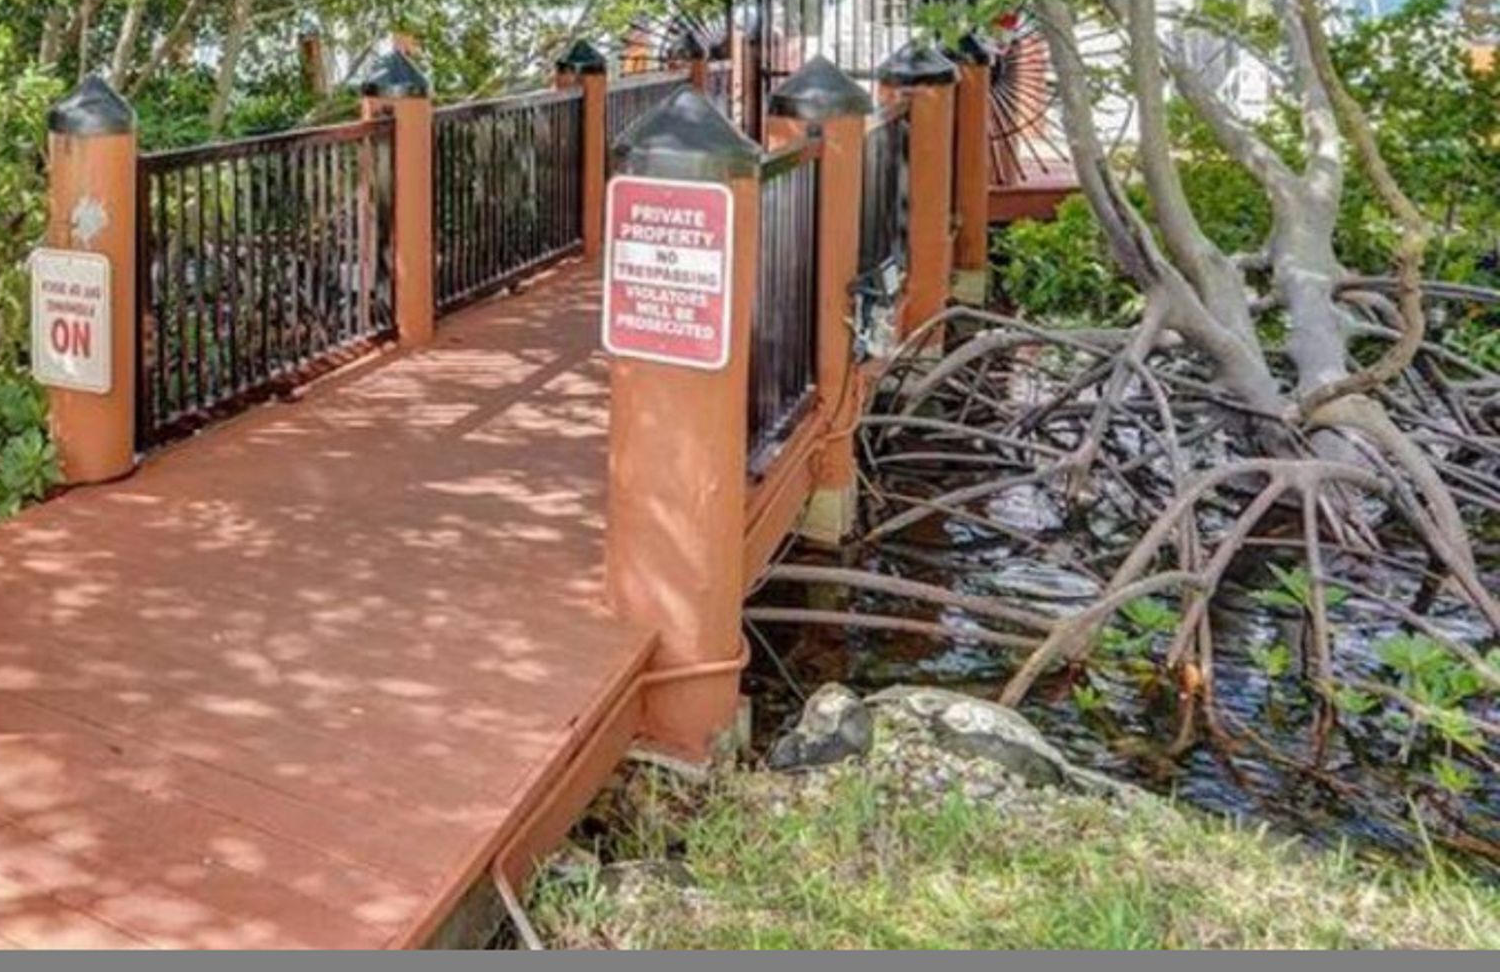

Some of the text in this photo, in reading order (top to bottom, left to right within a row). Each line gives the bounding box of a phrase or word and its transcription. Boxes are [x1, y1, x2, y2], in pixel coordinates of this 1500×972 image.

[630, 204, 705, 227] PRIVATE
[620, 223, 715, 247] PROPERTY
[656, 250, 679, 265] NO
[618, 263, 717, 287] TRESPASSING
[625, 285, 708, 308] VIOLATORS
[636, 301, 696, 322] WILL BE
[51, 317, 90, 358] ON
[615, 313, 715, 340] PROSECUTED
